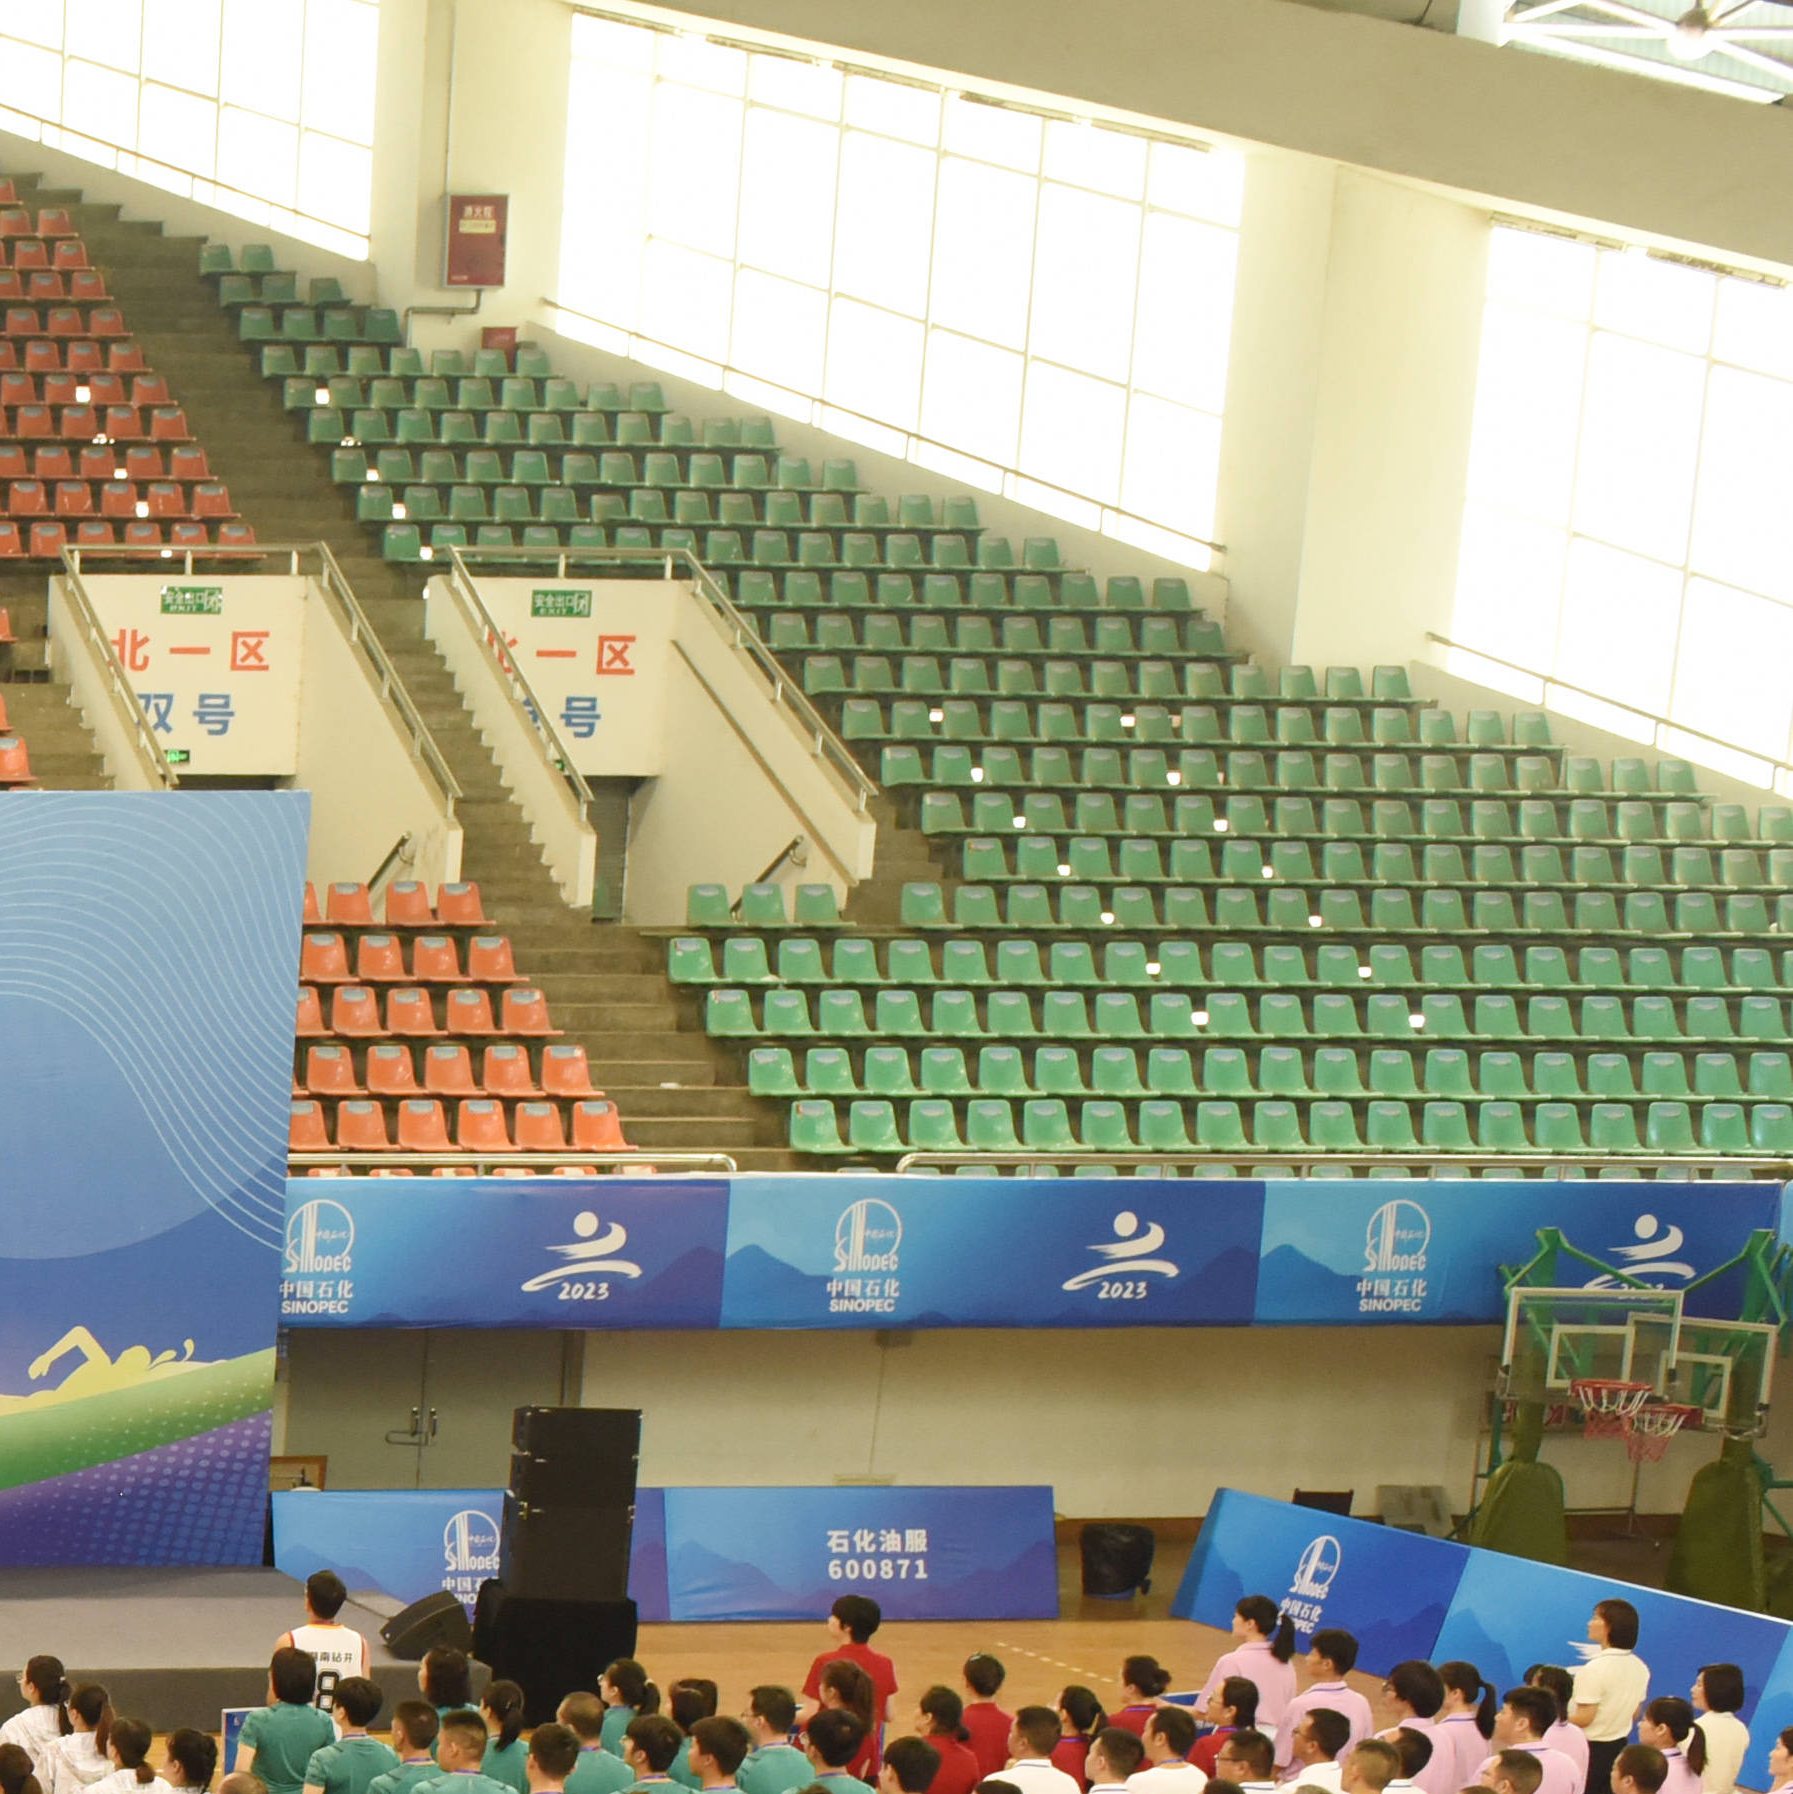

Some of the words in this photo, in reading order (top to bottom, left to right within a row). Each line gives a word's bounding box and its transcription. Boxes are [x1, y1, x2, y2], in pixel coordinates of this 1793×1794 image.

[534, 594, 573, 607] 安全出口
[279, 1280, 354, 1299] 中国石化
[558, 1281, 609, 1300] 2023
[827, 1279, 900, 1297] 中国石化
[1098, 1280, 1147, 1299] 2023
[1357, 1279, 1427, 1297] 中国石化
[281, 1301, 349, 1314] SINOPEC
[829, 1299, 896, 1312] SINOPEC
[1359, 1299, 1422, 1312] SINOPEC
[827, 1529, 928, 1553] 石化油服
[828, 1559, 928, 1580] 600871
